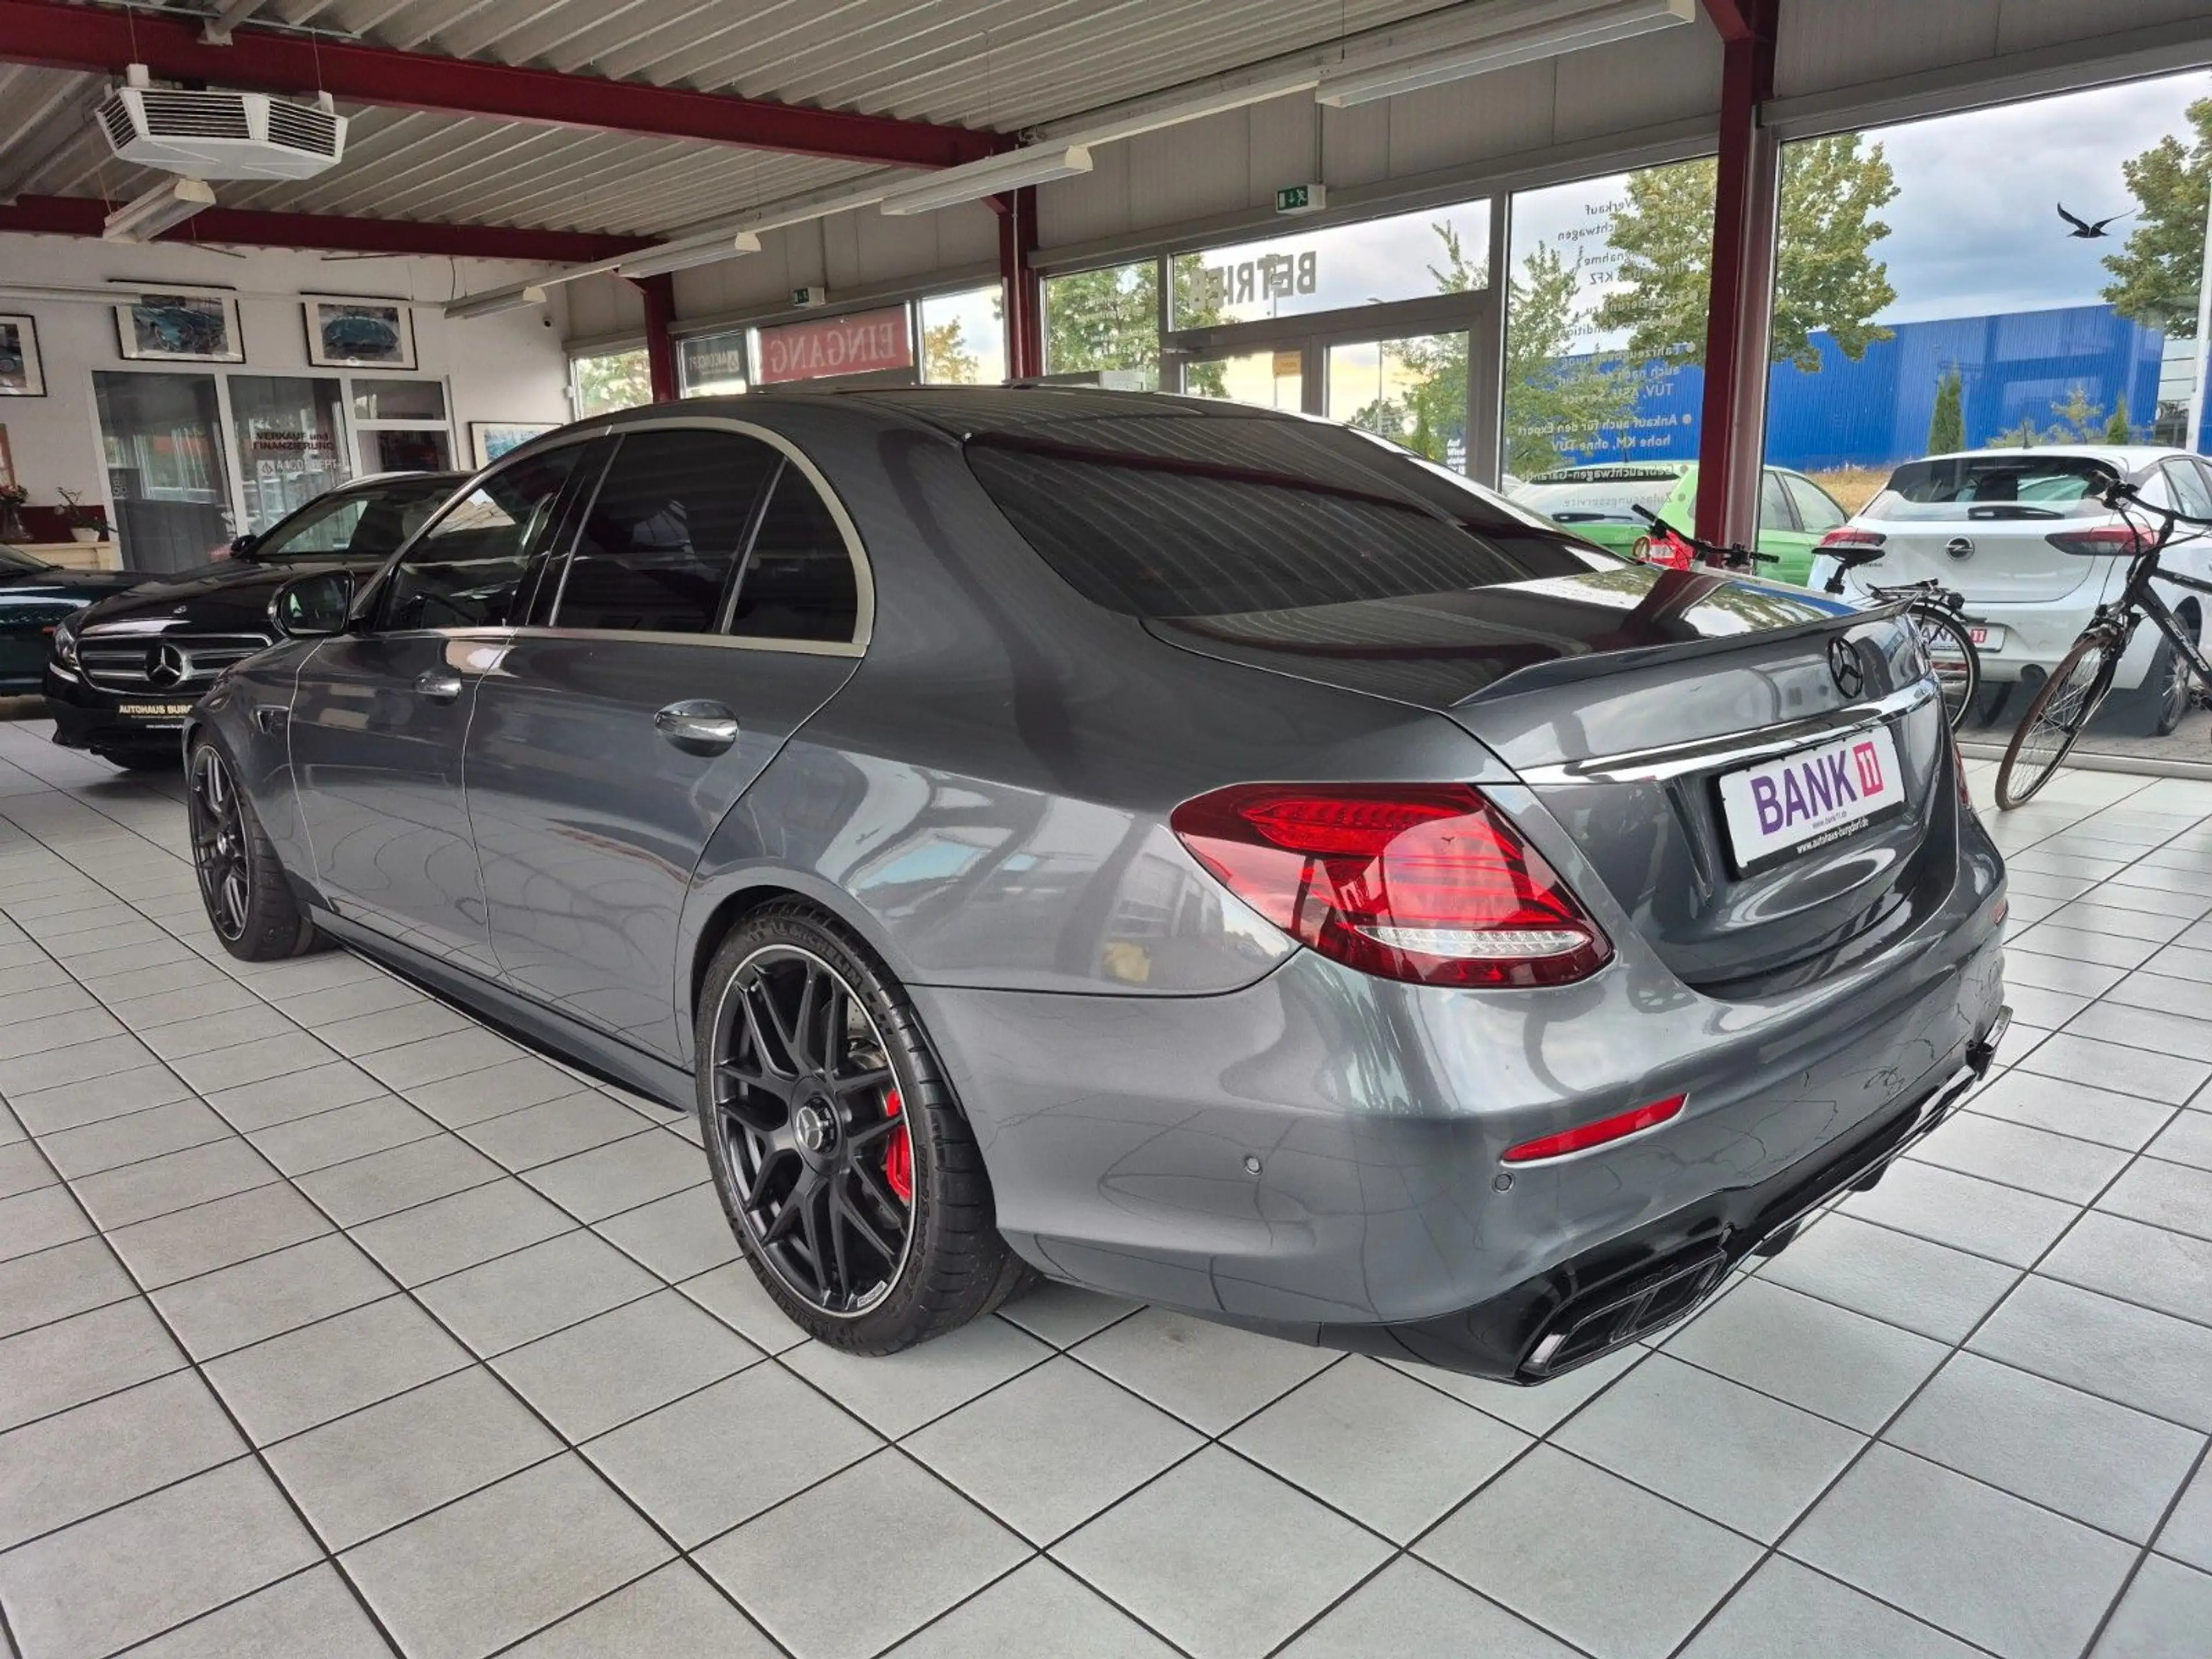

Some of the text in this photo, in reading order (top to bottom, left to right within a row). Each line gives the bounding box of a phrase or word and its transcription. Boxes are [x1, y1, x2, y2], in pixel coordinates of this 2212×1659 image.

[256, 431, 304, 440] VERKAUF
[253, 441, 334, 450] FINANZIERUNG
[276, 459, 336, 471] A4COEPT
[119, 704, 166, 714] AUTOHAUS
[1751, 751, 1858, 835] BANK
[1797, 816, 1869, 854] www.autohaus-burgdorf.de
